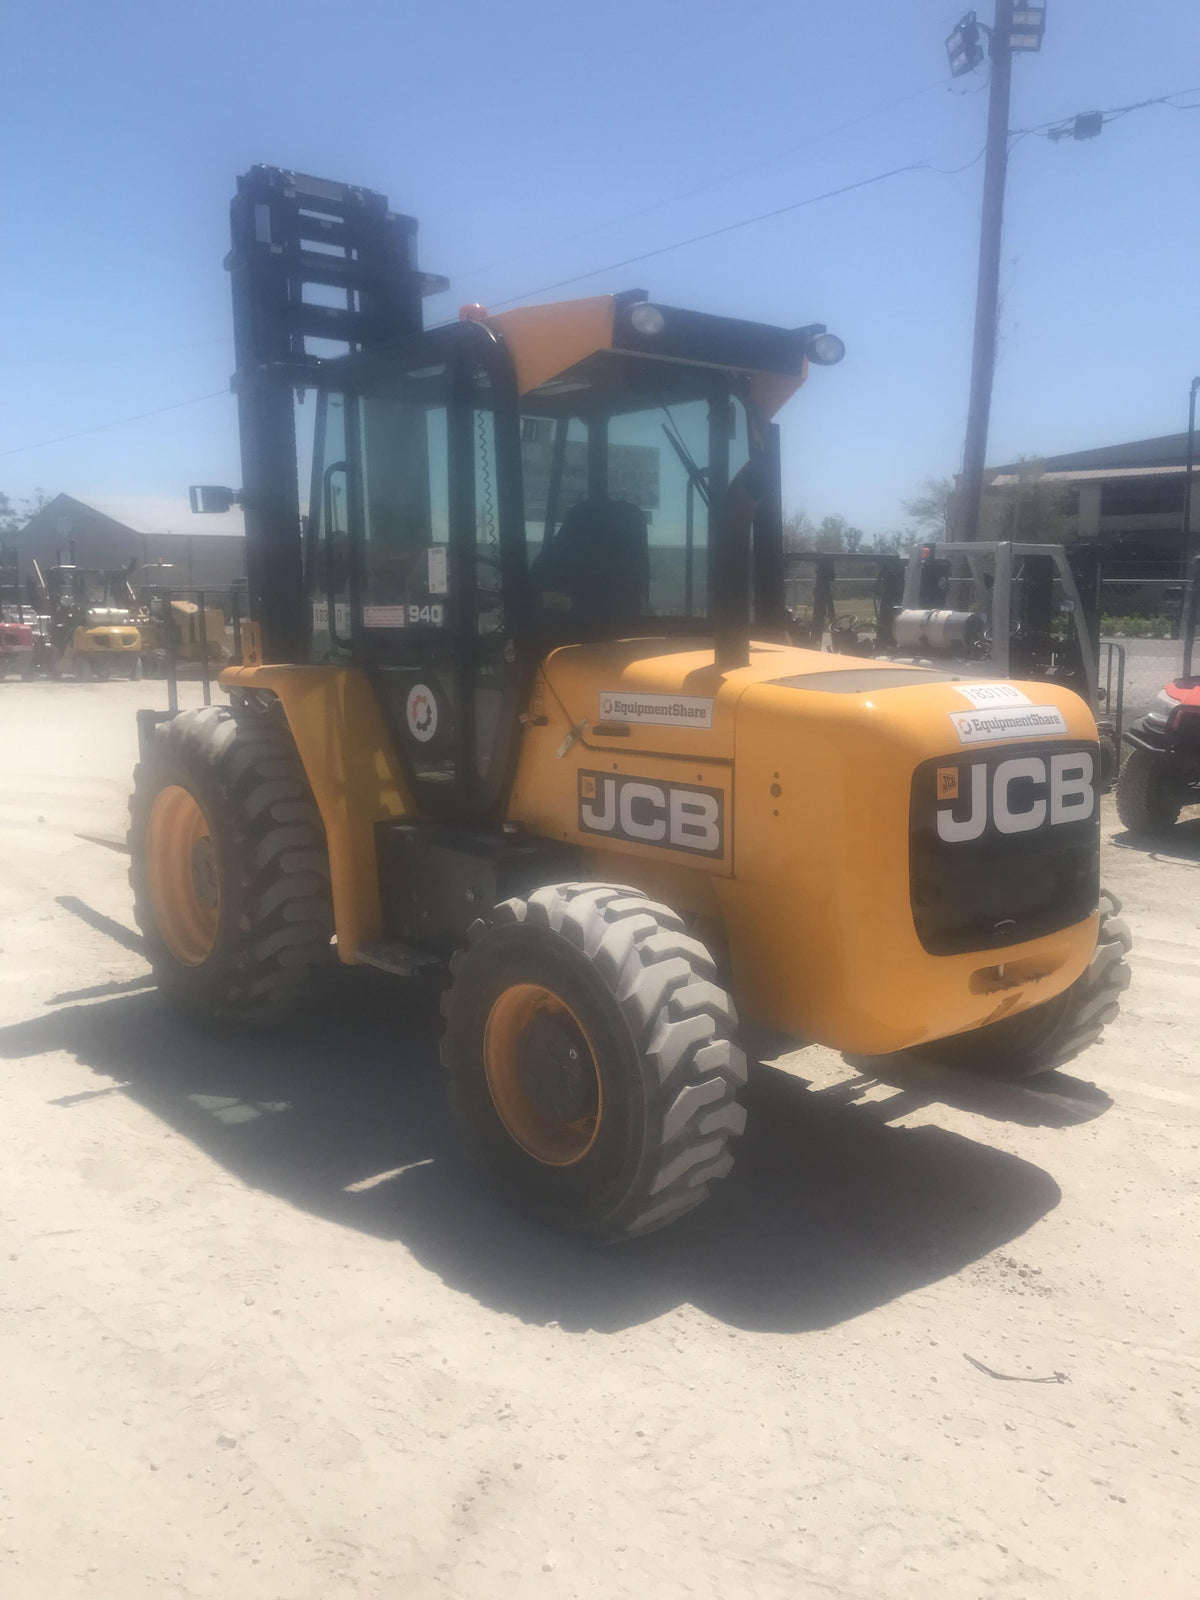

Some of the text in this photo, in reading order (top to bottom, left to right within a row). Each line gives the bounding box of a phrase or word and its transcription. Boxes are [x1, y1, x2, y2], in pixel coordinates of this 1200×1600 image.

[409, 605, 443, 623] 940
[963, 686, 1018, 700] 183110
[614, 701, 707, 718] EquipmentShare
[971, 714, 1061, 733] EquipmentShare
[937, 752, 1094, 843] JCB
[582, 779, 720, 851] JCB
